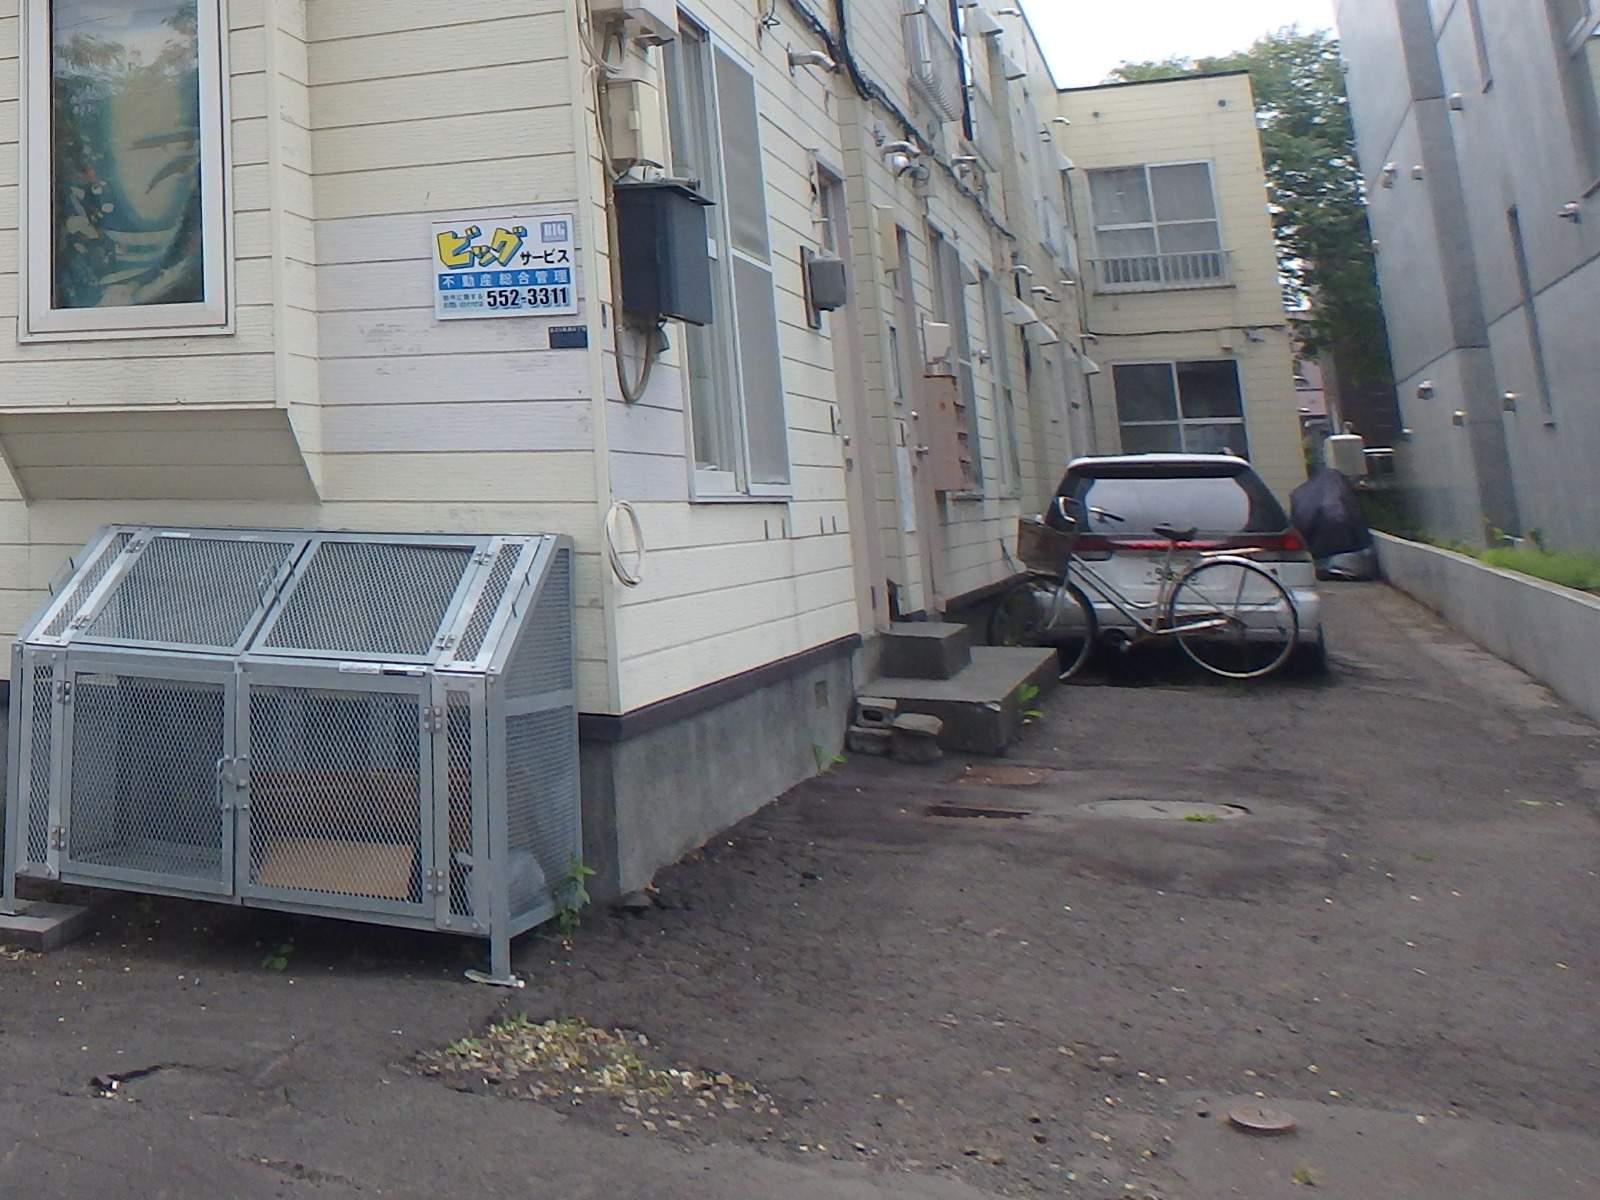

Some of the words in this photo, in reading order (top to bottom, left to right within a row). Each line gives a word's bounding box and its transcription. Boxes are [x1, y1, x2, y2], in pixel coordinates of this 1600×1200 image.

[437, 225, 528, 270] ビッグ
[520, 249, 569, 265] サービス
[442, 271, 568, 289] 不動産総合管理
[487, 288, 570, 308] 552-3311
